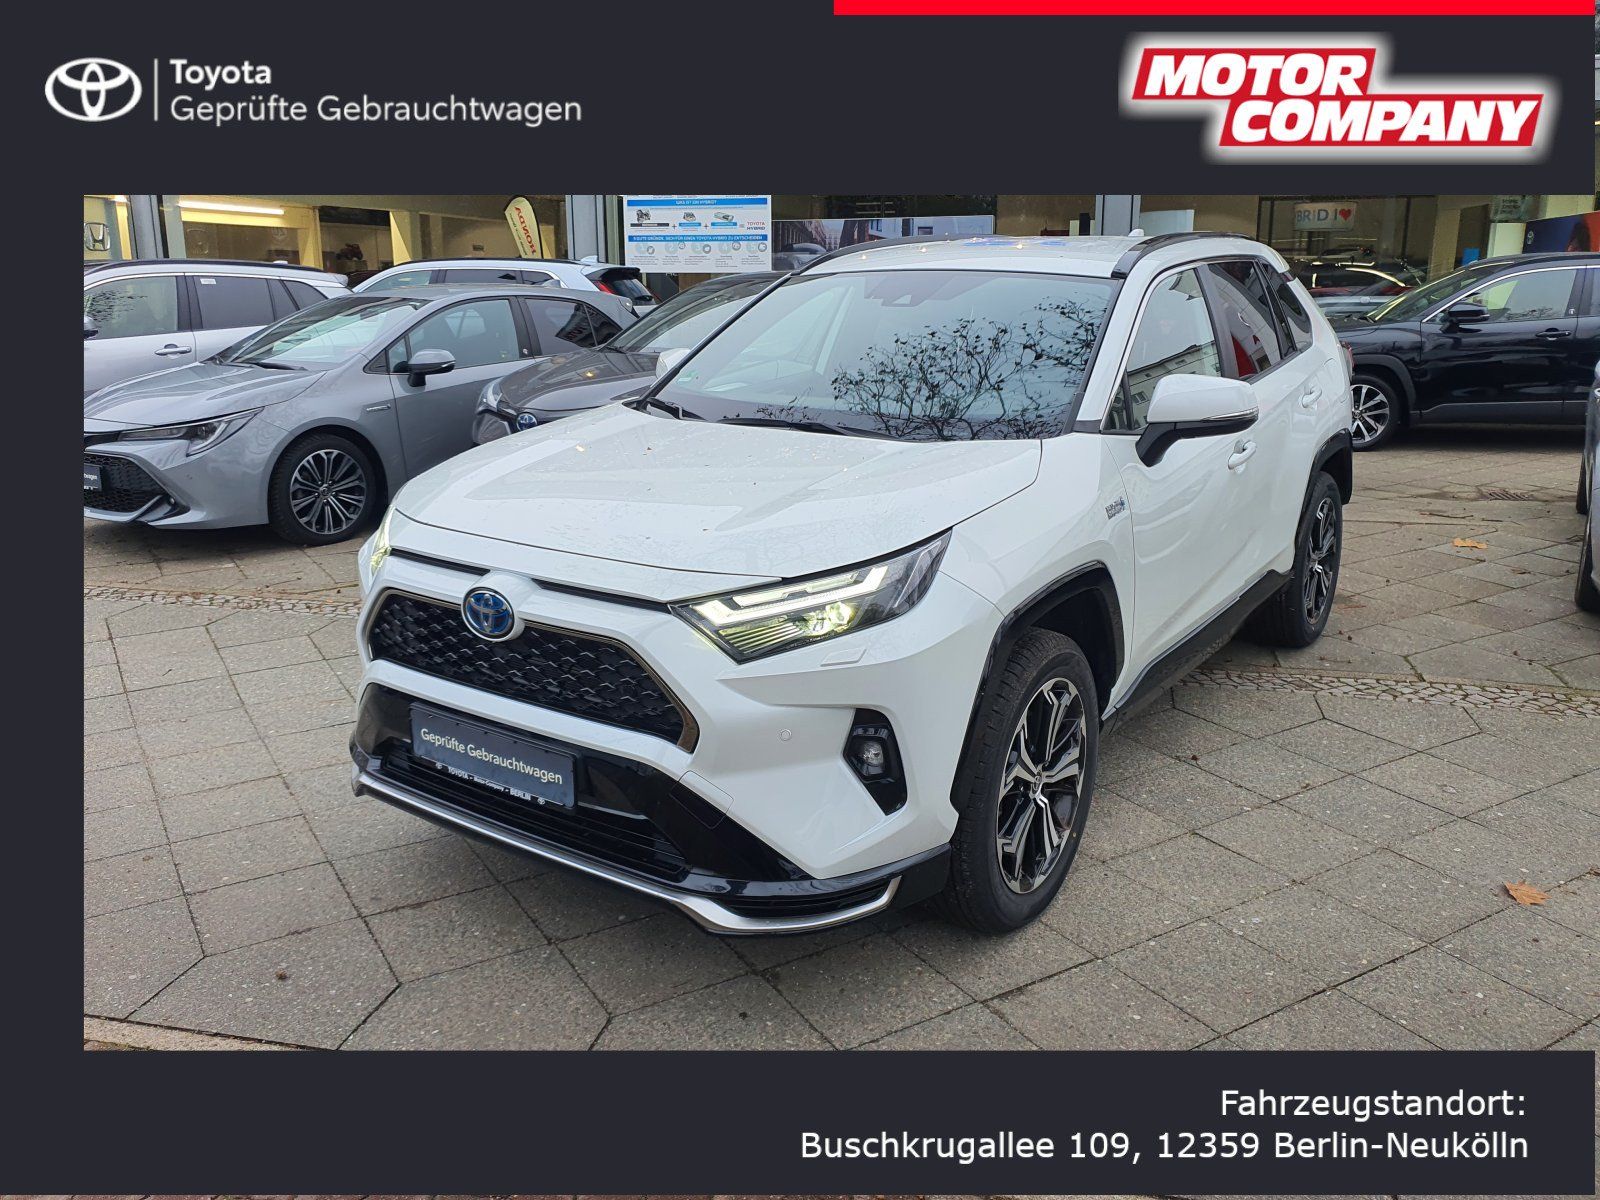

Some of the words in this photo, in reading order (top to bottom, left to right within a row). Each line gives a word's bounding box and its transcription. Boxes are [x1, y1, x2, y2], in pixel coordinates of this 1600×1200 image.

[420, 728, 466, 753] Geprüfte
[467, 744, 563, 785] Gebrauchtwagen
[448, 766, 469, 780] TOYOTA
[510, 788, 531, 801] BERLIN
